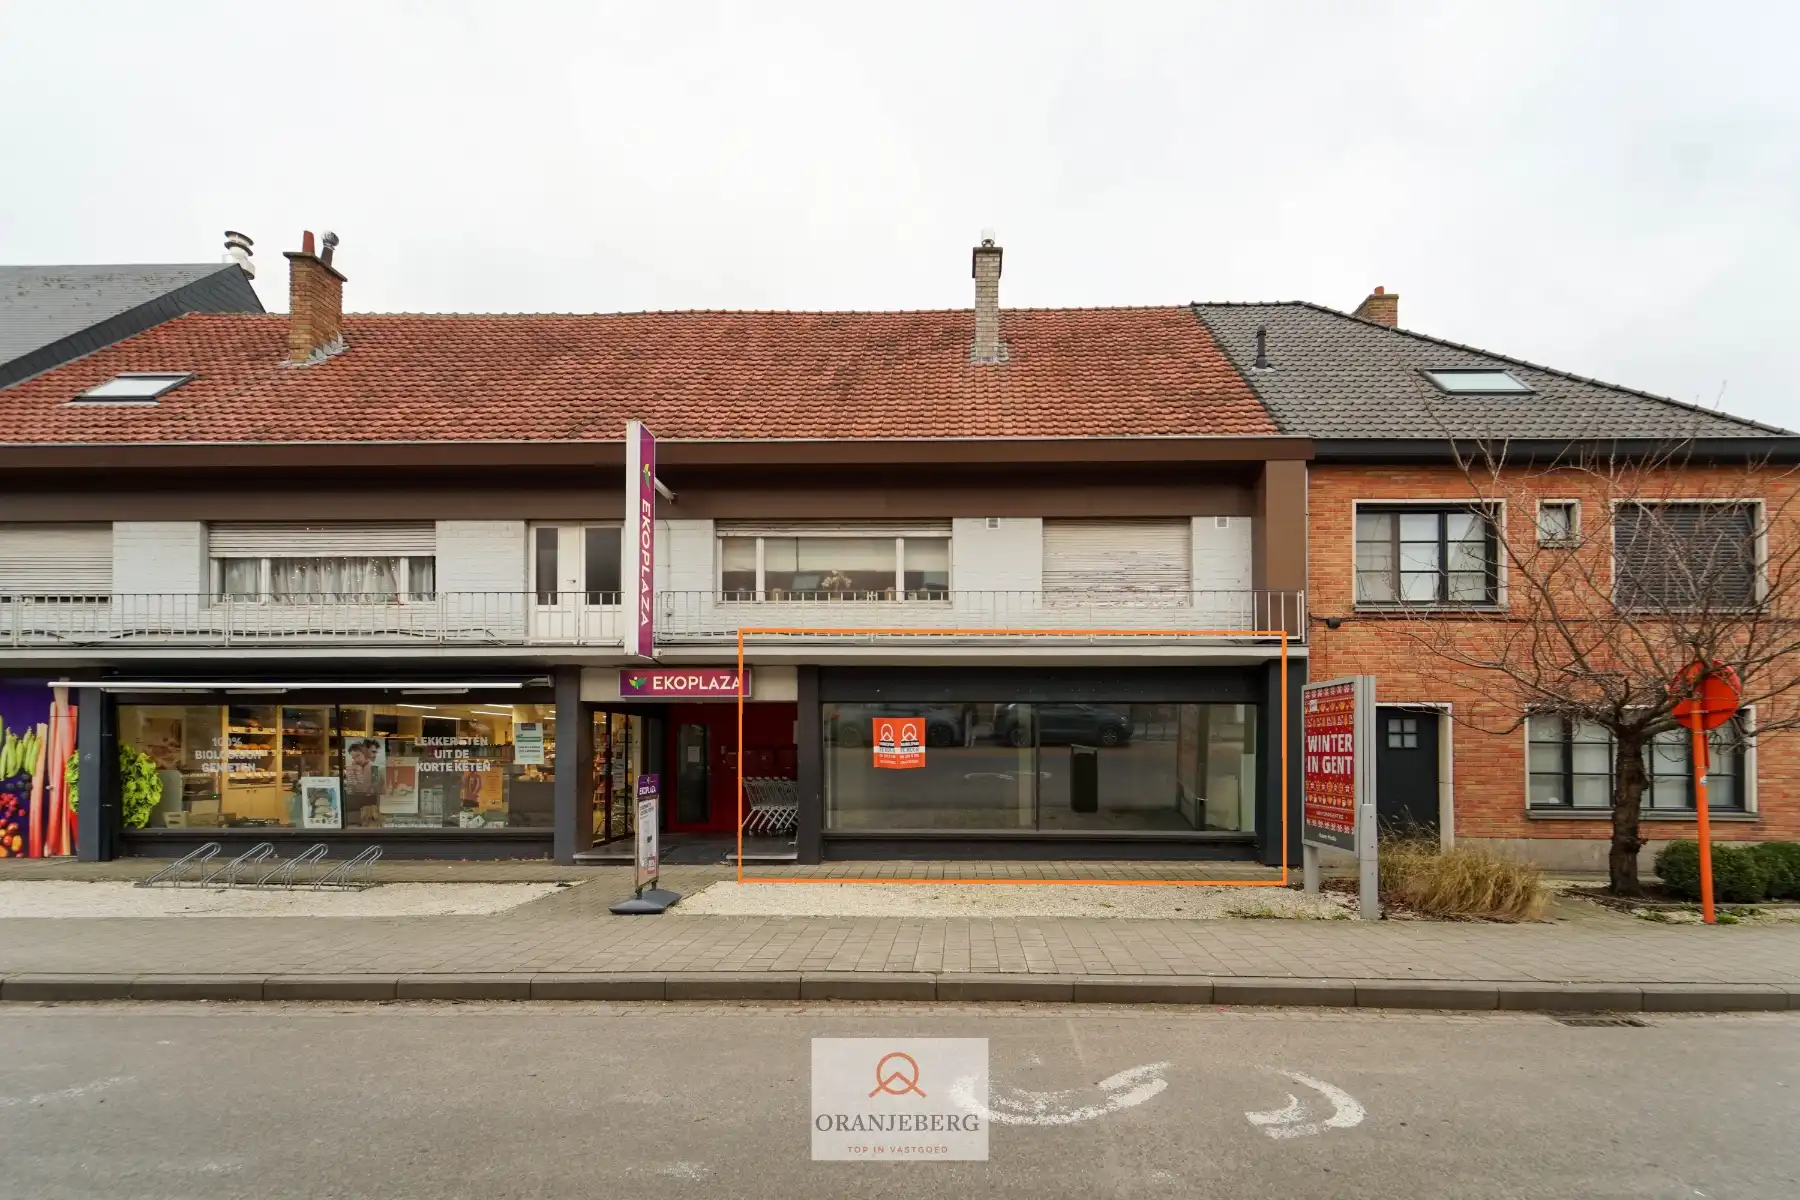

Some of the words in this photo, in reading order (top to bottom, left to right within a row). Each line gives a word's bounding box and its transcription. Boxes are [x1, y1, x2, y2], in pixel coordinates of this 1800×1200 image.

[641, 498, 650, 626] EKOPLAZA
[653, 676, 741, 690] EKOPLAZA
[212, 736, 243, 747] 100%
[415, 736, 457, 746] LEKKER
[458, 736, 488, 746] ETEN
[1307, 733, 1353, 753] WINTER
[434, 749, 454, 759] UIT
[454, 749, 470, 759] DE
[201, 763, 256, 772] GENIETEN
[416, 762, 453, 772] KORTE
[455, 762, 491, 772] KETEN
[1307, 755, 1319, 773] IN
[1322, 755, 1353, 775] GENT
